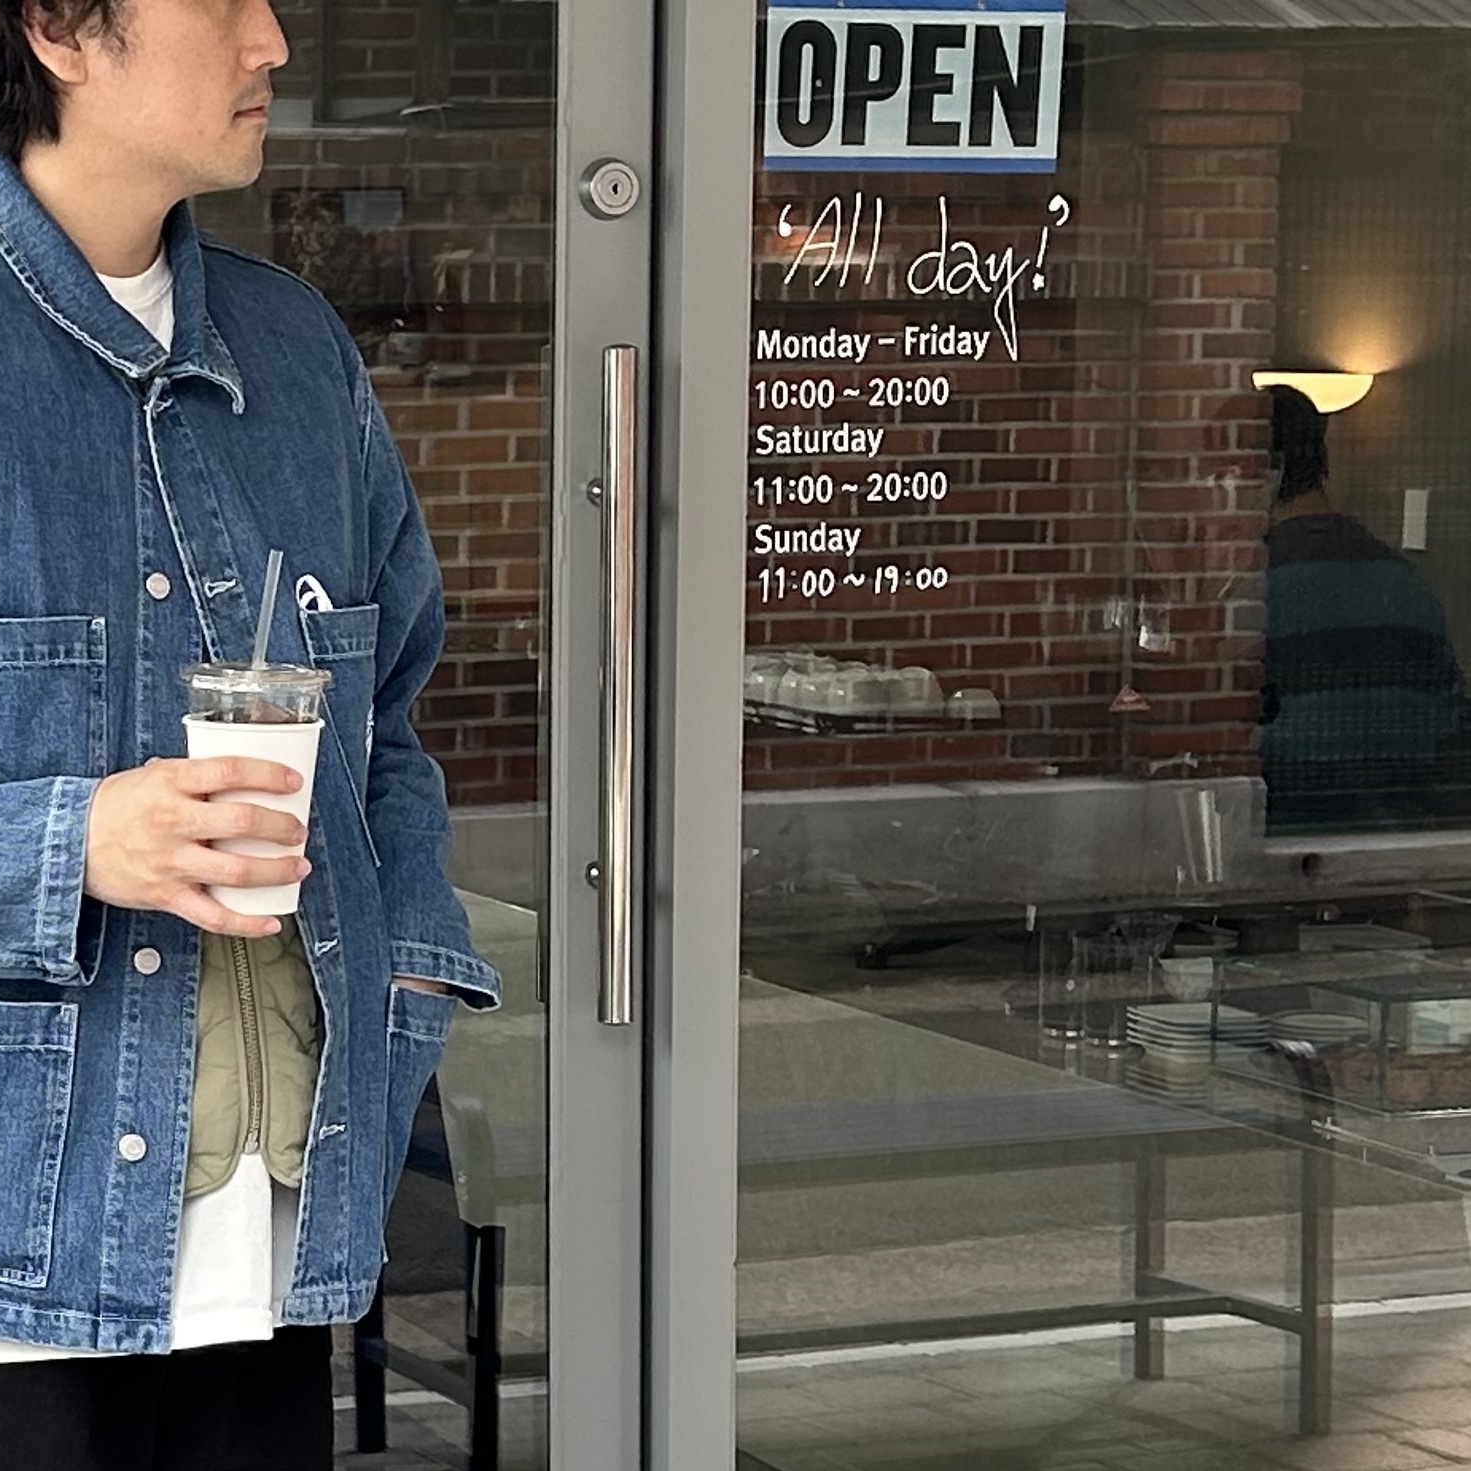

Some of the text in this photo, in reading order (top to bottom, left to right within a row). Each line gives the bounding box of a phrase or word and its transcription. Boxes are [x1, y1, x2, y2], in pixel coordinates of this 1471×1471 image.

[777, 20, 1044, 148] OPEN
[757, 327, 871, 363] Monday
[905, 323, 991, 360] Friday
[755, 379, 835, 409] 10:00
[868, 376, 949, 407] 20:00
[755, 422, 884, 459] Saturday
[753, 474, 833, 506] 11:00
[866, 471, 948, 502] 20:00
[754, 521, 862, 557] Sunday
[758, 566, 835, 603] 11:00
[874, 565, 948, 594] 19:00
